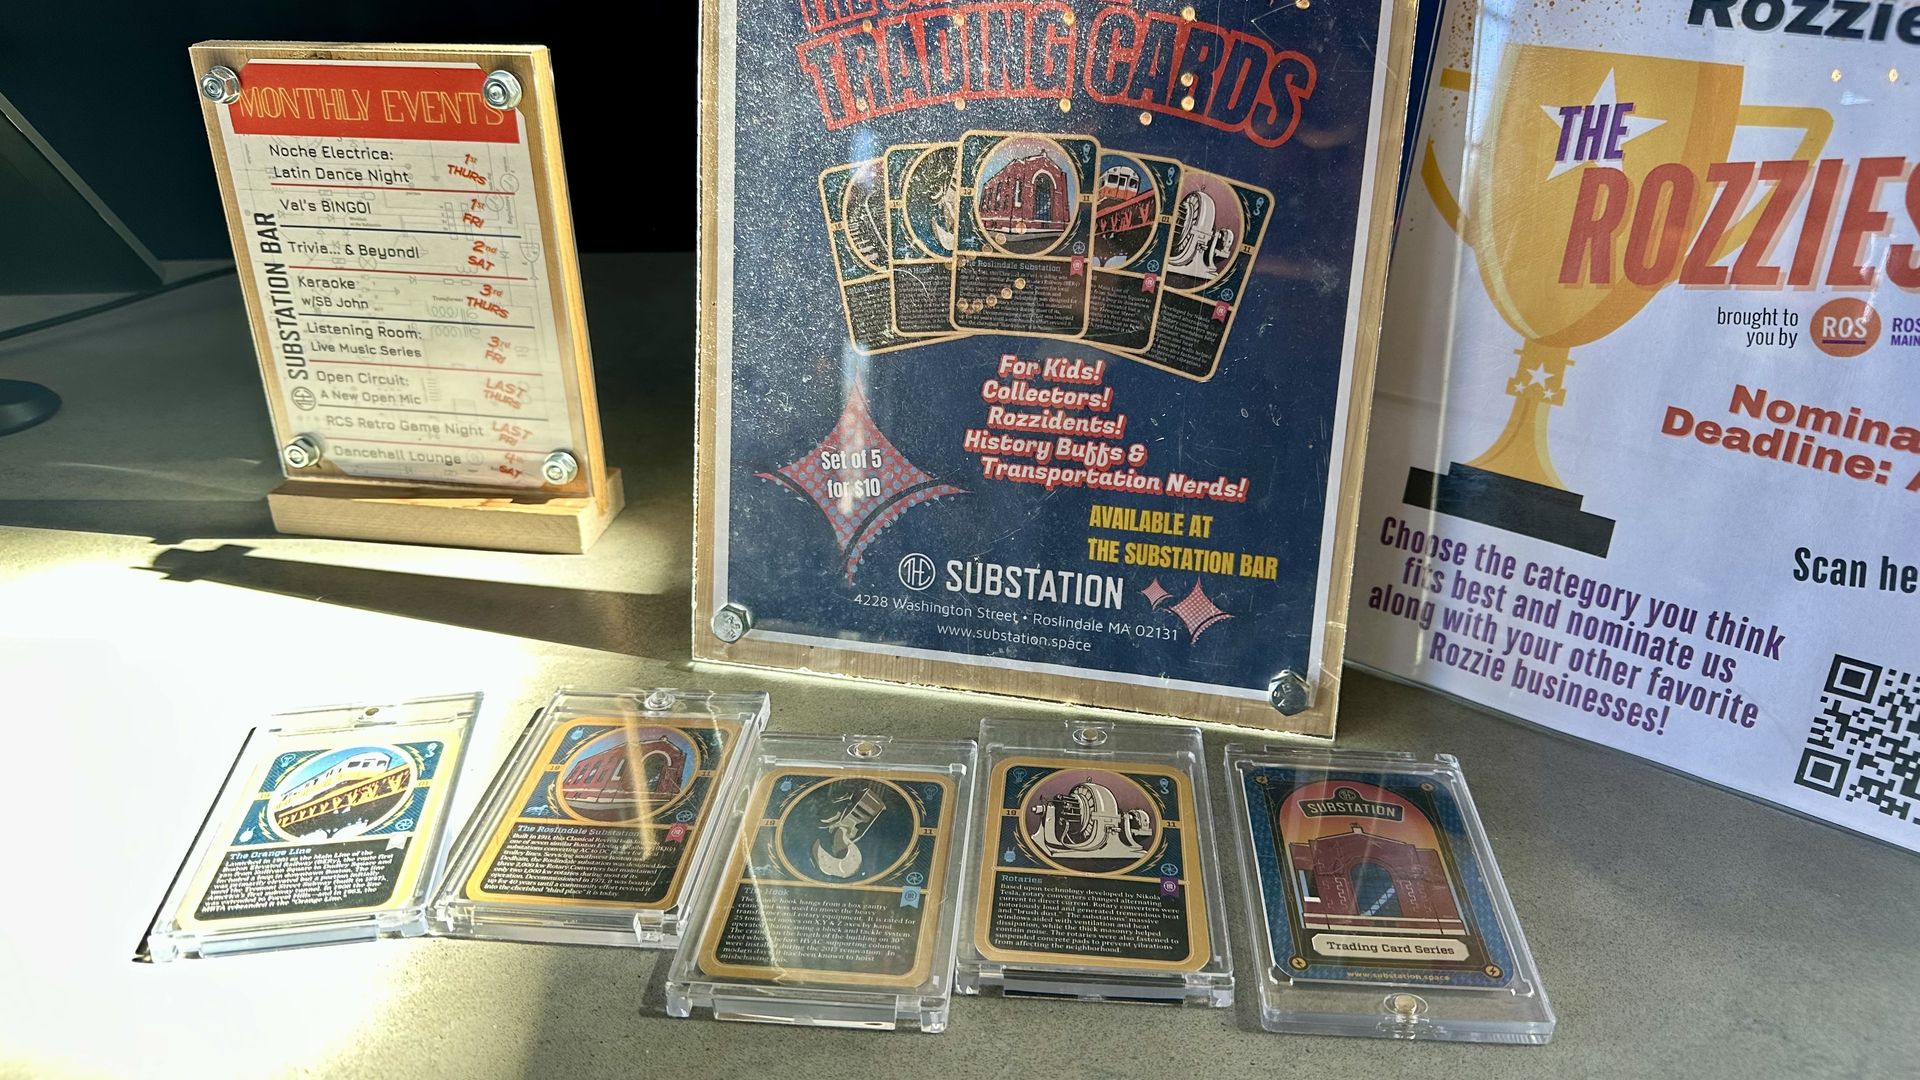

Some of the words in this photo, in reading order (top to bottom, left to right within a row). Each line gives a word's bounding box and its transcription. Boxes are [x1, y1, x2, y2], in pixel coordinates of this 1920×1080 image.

[796, 2, 1075, 131] TRADING
[1084, 6, 1318, 148] CARDS
[239, 87, 370, 121] MONTHLY
[1554, 102, 1634, 162] THE
[269, 144, 317, 158] Noche
[322, 145, 394, 161] Electrica:
[273, 166, 311, 180] Latin
[315, 167, 363, 182] Dance
[368, 168, 410, 185] Night
[447, 164, 487, 186] THURS
[279, 199, 317, 212] Val's
[462, 212, 484, 229] FRI
[1558, 156, 1920, 288] ROZZIES
[254, 212, 283, 254] BAR
[288, 241, 341, 255] Trivia...
[345, 244, 355, 256] &
[472, 240, 498, 254] 2nd
[467, 255, 496, 272] SAT
[297, 275, 356, 290] Karaoke
[480, 283, 503, 297] 3rd
[301, 296, 332, 309] w/SB
[336, 297, 369, 310] John
[466, 296, 509, 319] THURS
[264, 262, 308, 380] SUBSTATION
[1717, 306, 1778, 329] brought
[1783, 308, 1798, 327] to
[1822, 316, 1868, 338] ROS
[307, 322, 373, 339] Listening
[377, 326, 422, 339] Room:
[1746, 330, 1774, 348] you
[1779, 328, 1798, 348] by
[1890, 335, 1920, 347] MAIN
[310, 341, 335, 353] Live
[340, 343, 377, 355] Music
[380, 345, 422, 358] Series
[484, 350, 507, 364] FRI
[316, 371, 353, 384] Open
[358, 372, 409, 386] Circuit:
[999, 353, 1040, 377] For
[1043, 357, 1104, 383] Kids!
[320, 390, 329, 399] A
[332, 390, 358, 401] New
[362, 392, 396, 405] Open
[400, 394, 422, 405] Mic
[485, 378, 527, 396] LAST
[982, 379, 1112, 410] Collectors!
[483, 389, 522, 410] THURS
[326, 415, 354, 427] RCS
[358, 417, 395, 430] Retro
[400, 420, 440, 433] Game
[445, 423, 484, 437] Night
[987, 405, 1126, 437] Rozzidents!
[1728, 384, 1920, 454] Nomina
[491, 421, 533, 440] LAST
[498, 433, 519, 446] FRI
[333, 445, 405, 461] Dancehall
[409, 452, 461, 466] Lounge
[963, 428, 1052, 462] History
[1056, 436, 1124, 468] Buffs
[1127, 443, 1147, 465] &
[1661, 405, 1892, 485] Deadline:
[821, 451, 847, 470] Set
[851, 450, 867, 468] of
[871, 449, 882, 468] 5
[827, 480, 850, 499] for
[854, 477, 881, 499] $10
[981, 456, 1161, 490] Transportation
[1165, 472, 1249, 500] Nerds!
[1089, 504, 1184, 535] AVAILABLE
[1188, 513, 1214, 539] AT
[1087, 538, 1120, 563] THE
[1124, 544, 1235, 577] SUBSTATION
[1238, 554, 1279, 581] BAR
[1793, 547, 1867, 588] Scan
[1879, 556, 1918, 594] he
[946, 560, 1124, 610] SUBSTATION
[1380, 516, 1467, 566] Choose
[1474, 543, 1516, 580] the
[1523, 562, 1641, 621] category
[1644, 598, 1698, 635] you
[1705, 611, 1786, 660] think
[853, 594, 888, 608] 4228
[892, 598, 972, 618] Washington
[977, 607, 1018, 622] Street
[1033, 613, 1103, 633] Roslindale
[1108, 622, 1130, 635] MA
[1135, 624, 1177, 641] 02131
[1451, 570, 1507, 613] best
[1512, 594, 1561, 630] and
[1565, 610, 1694, 670] nominate
[1701, 652, 1737, 684] us
[937, 624, 1091, 652] www.substation.space
[1369, 584, 1435, 630] along
[1442, 607, 1498, 645] with
[1502, 626, 1564, 665] your
[1568, 647, 1642, 690] other
[1647, 666, 1759, 729] favorite
[1429, 632, 1505, 682] Rozzie
[1512, 658, 1670, 736] businesses!
[1307, 802, 1395, 817] SUBSTATION
[537, 825, 587, 835] Roslindale
[251, 849, 287, 859] Orange
[289, 848, 311, 856] Line
[1001, 874, 1043, 884] Rotaries
[1044, 887, 1085, 895] technology
[1086, 890, 1123, 898] developed
[1136, 893, 1161, 901] Nikola
[1088, 896, 1119, 904] changed
[1120, 899, 1162, 907] alternating
[1327, 941, 1378, 953] Trading
[1381, 943, 1411, 953] Card
[1414, 945, 1455, 955] Series
[1346, 971, 1450, 981] www.substation.space
